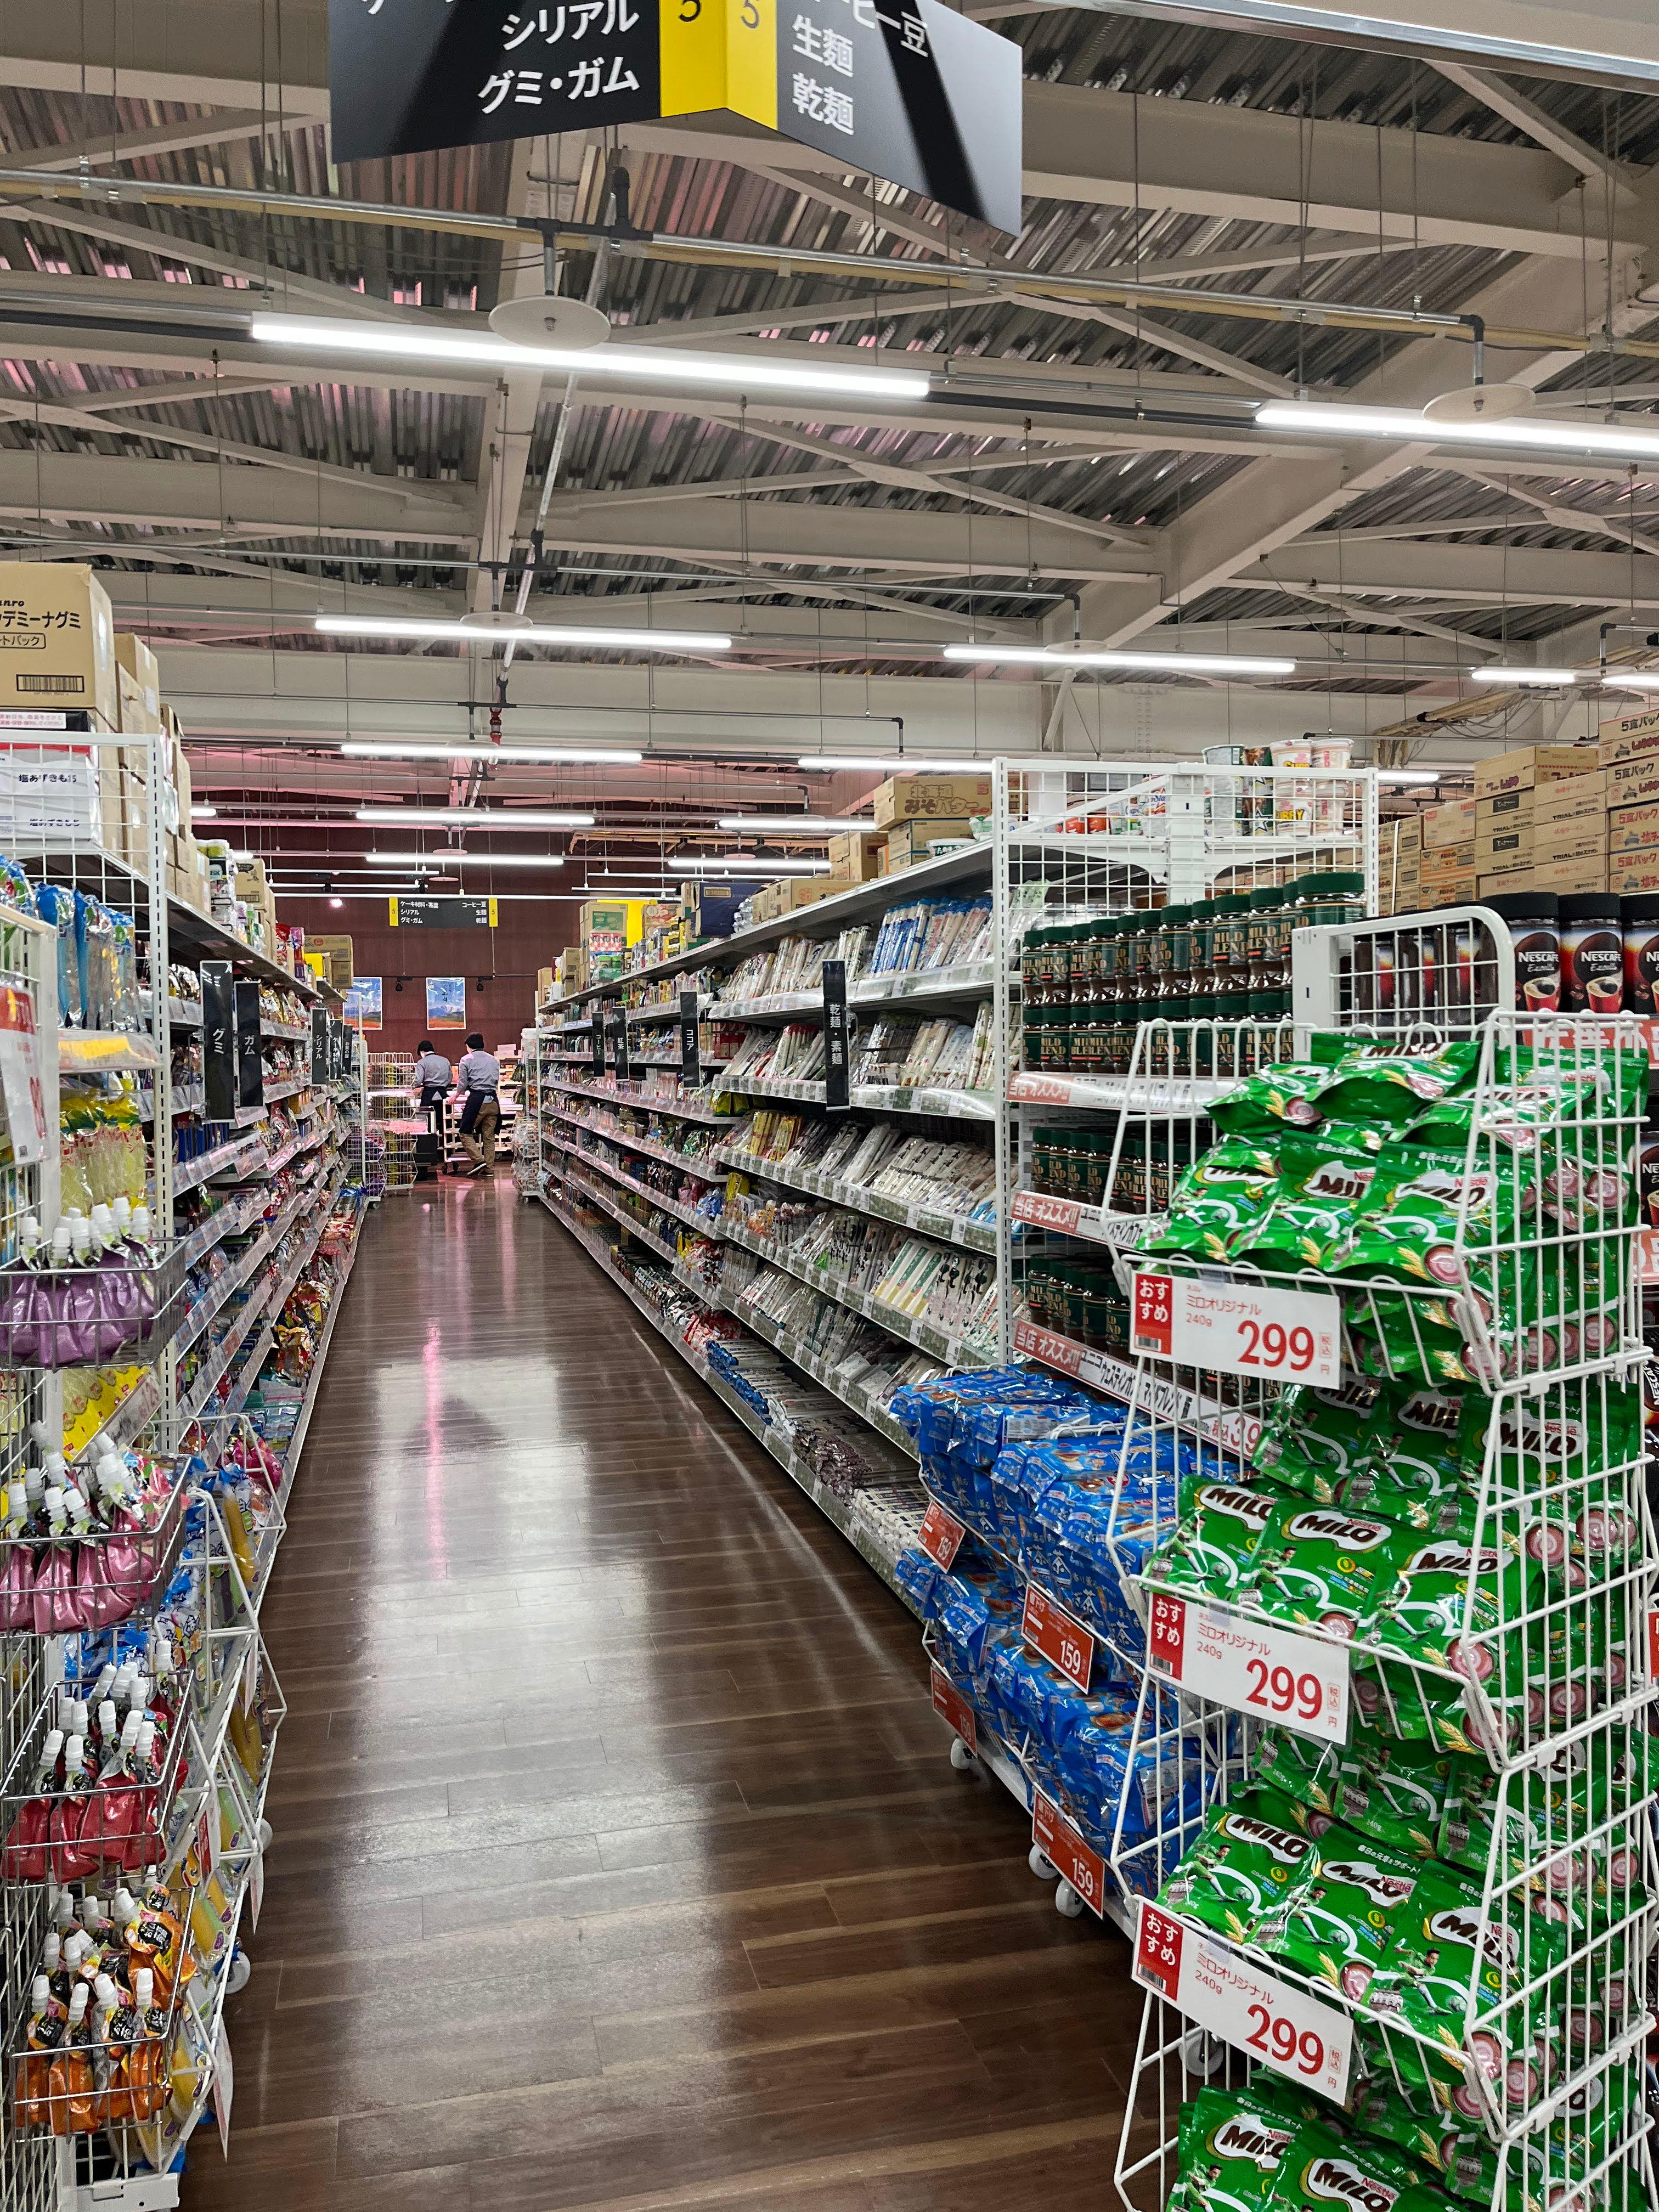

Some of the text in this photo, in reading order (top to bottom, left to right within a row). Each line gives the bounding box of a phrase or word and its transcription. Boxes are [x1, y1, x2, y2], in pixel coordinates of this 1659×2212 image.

[501, 0, 640, 50] シリアル
[477, 57, 640, 114] グミ・ガム
[0, 611, 81, 629] デミーナグミ
[0, 635, 40, 646] トパック
[904, 797, 979, 815] みそバター
[212, 1028, 224, 1055] グミ
[244, 1035, 256, 1056] ガム
[313, 1034, 323, 1060] シリアル
[616, 1037, 625, 1051] 紅茶
[686, 1029, 694, 1051] ココア
[1186, 1294, 1263, 1316] ミロオリジナル
[1186, 1312, 1213, 1328] 240g
[1017, 1325, 1037, 1352] 当店
[1237, 1319, 1315, 1372] 299
[1296, 1515, 1378, 1543] MILO
[936, 1536, 952, 1561] 159
[1197, 1641, 1223, 1660] 240g
[1198, 1623, 1272, 1656] ミロオリジナル
[1060, 1639, 1081, 1675] 159
[1246, 1658, 1323, 1720] 299
[1231, 1816, 1310, 1858] MILO
[1072, 1858, 1094, 1897] 159
[1194, 1970, 1222, 1995] 240g
[1195, 1951, 1274, 2005] ミロオリジナル
[1245, 2004, 1324, 2075] 299
[1313, 2162, 1391, 2211] MILO
